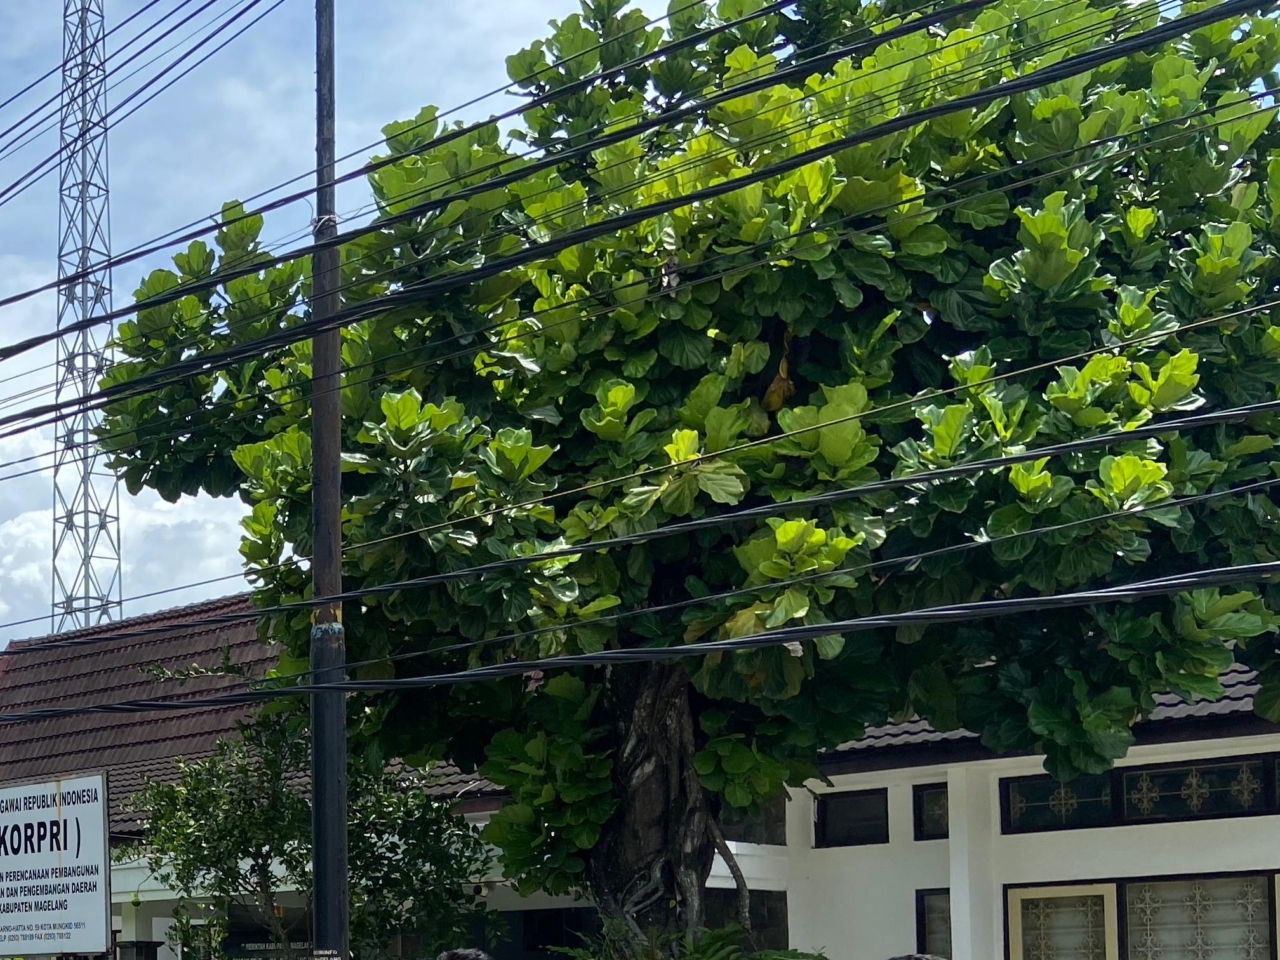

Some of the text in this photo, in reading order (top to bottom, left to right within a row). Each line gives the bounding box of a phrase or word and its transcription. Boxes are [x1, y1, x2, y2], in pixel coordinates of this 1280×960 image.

[24, 793, 57, 811] REPUBLIK
[60, 788, 98, 806] INDONESIA
[5, 868, 49, 882] PERENCANAAN
[51, 864, 99, 879] PEMBANGUNAN
[6, 887, 18, 898] DAN
[20, 882, 70, 897] PENGEMBANGAN
[72, 881, 97, 894] DAERAH
[34, 900, 68, 912] MAGELANG
